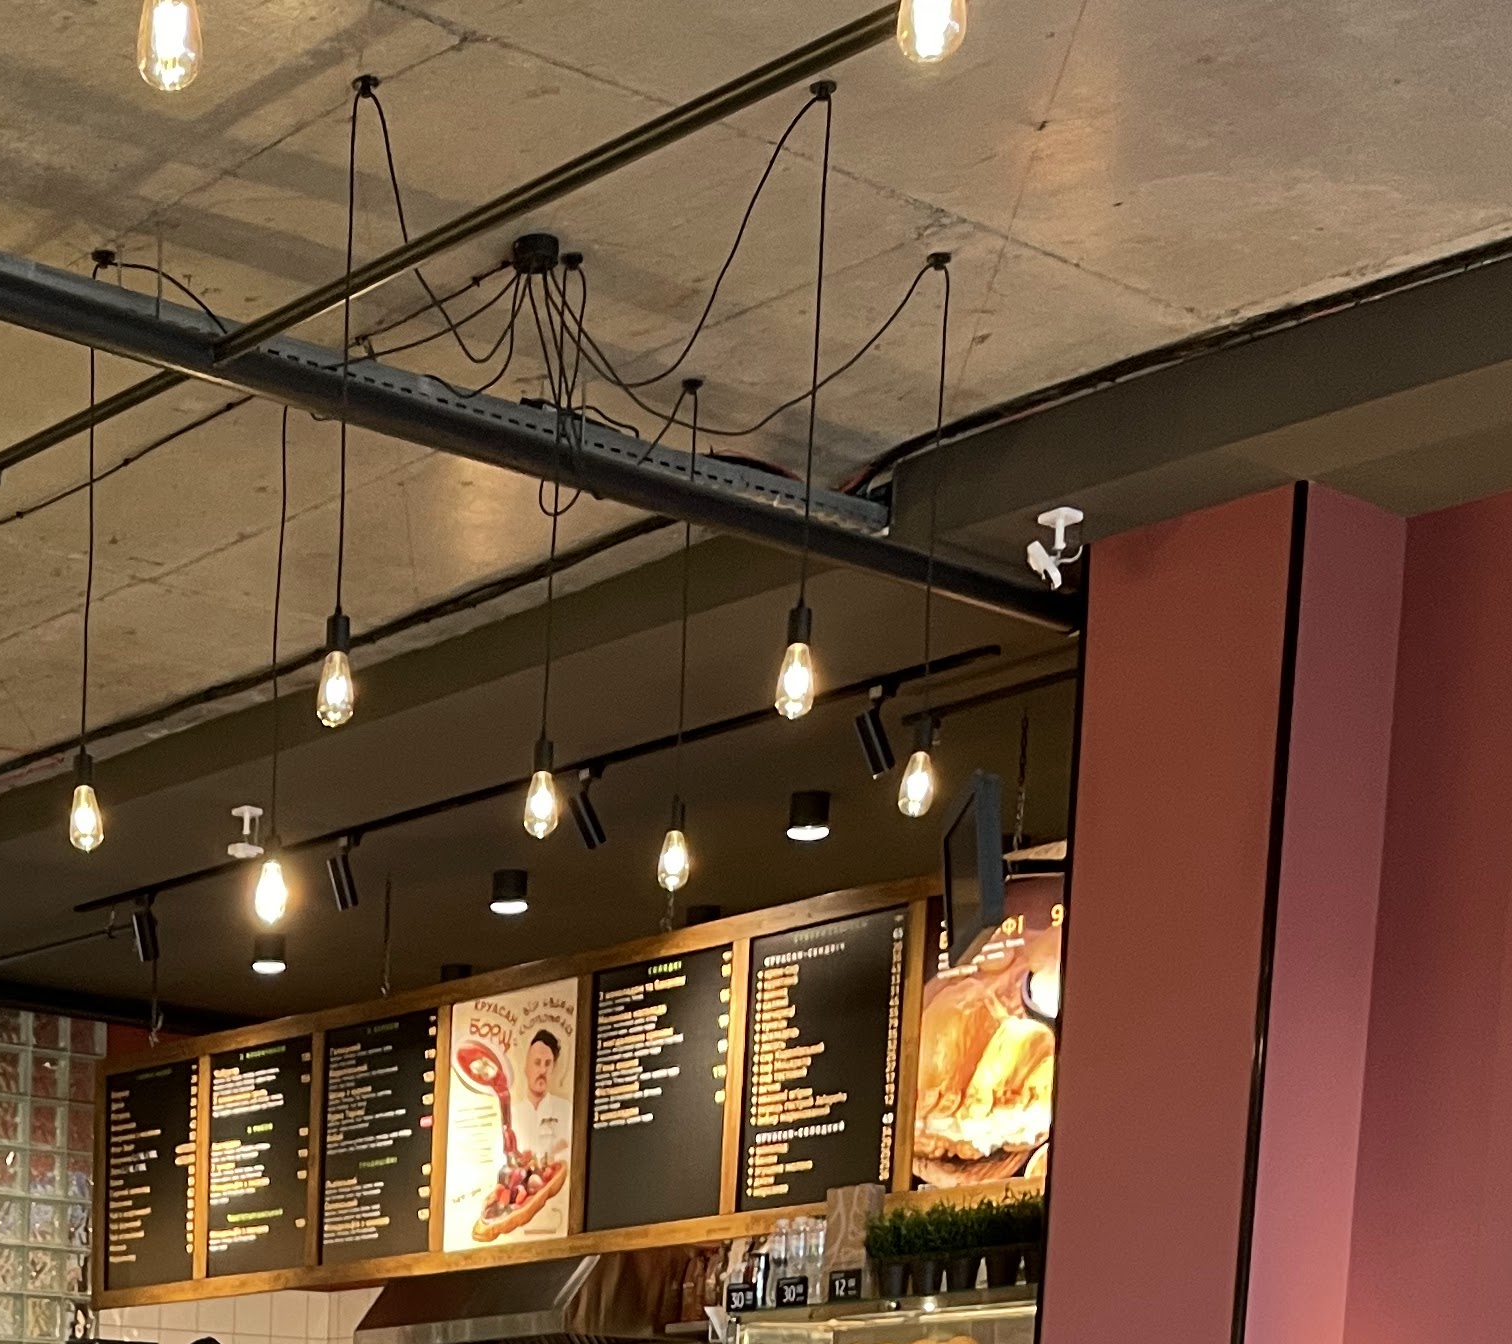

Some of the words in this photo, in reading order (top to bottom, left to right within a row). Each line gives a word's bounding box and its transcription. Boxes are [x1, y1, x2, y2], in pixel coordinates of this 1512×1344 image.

[782, 1284, 796, 1303] 30
[834, 1278, 847, 1297] 12
[730, 1291, 745, 1310] 30
